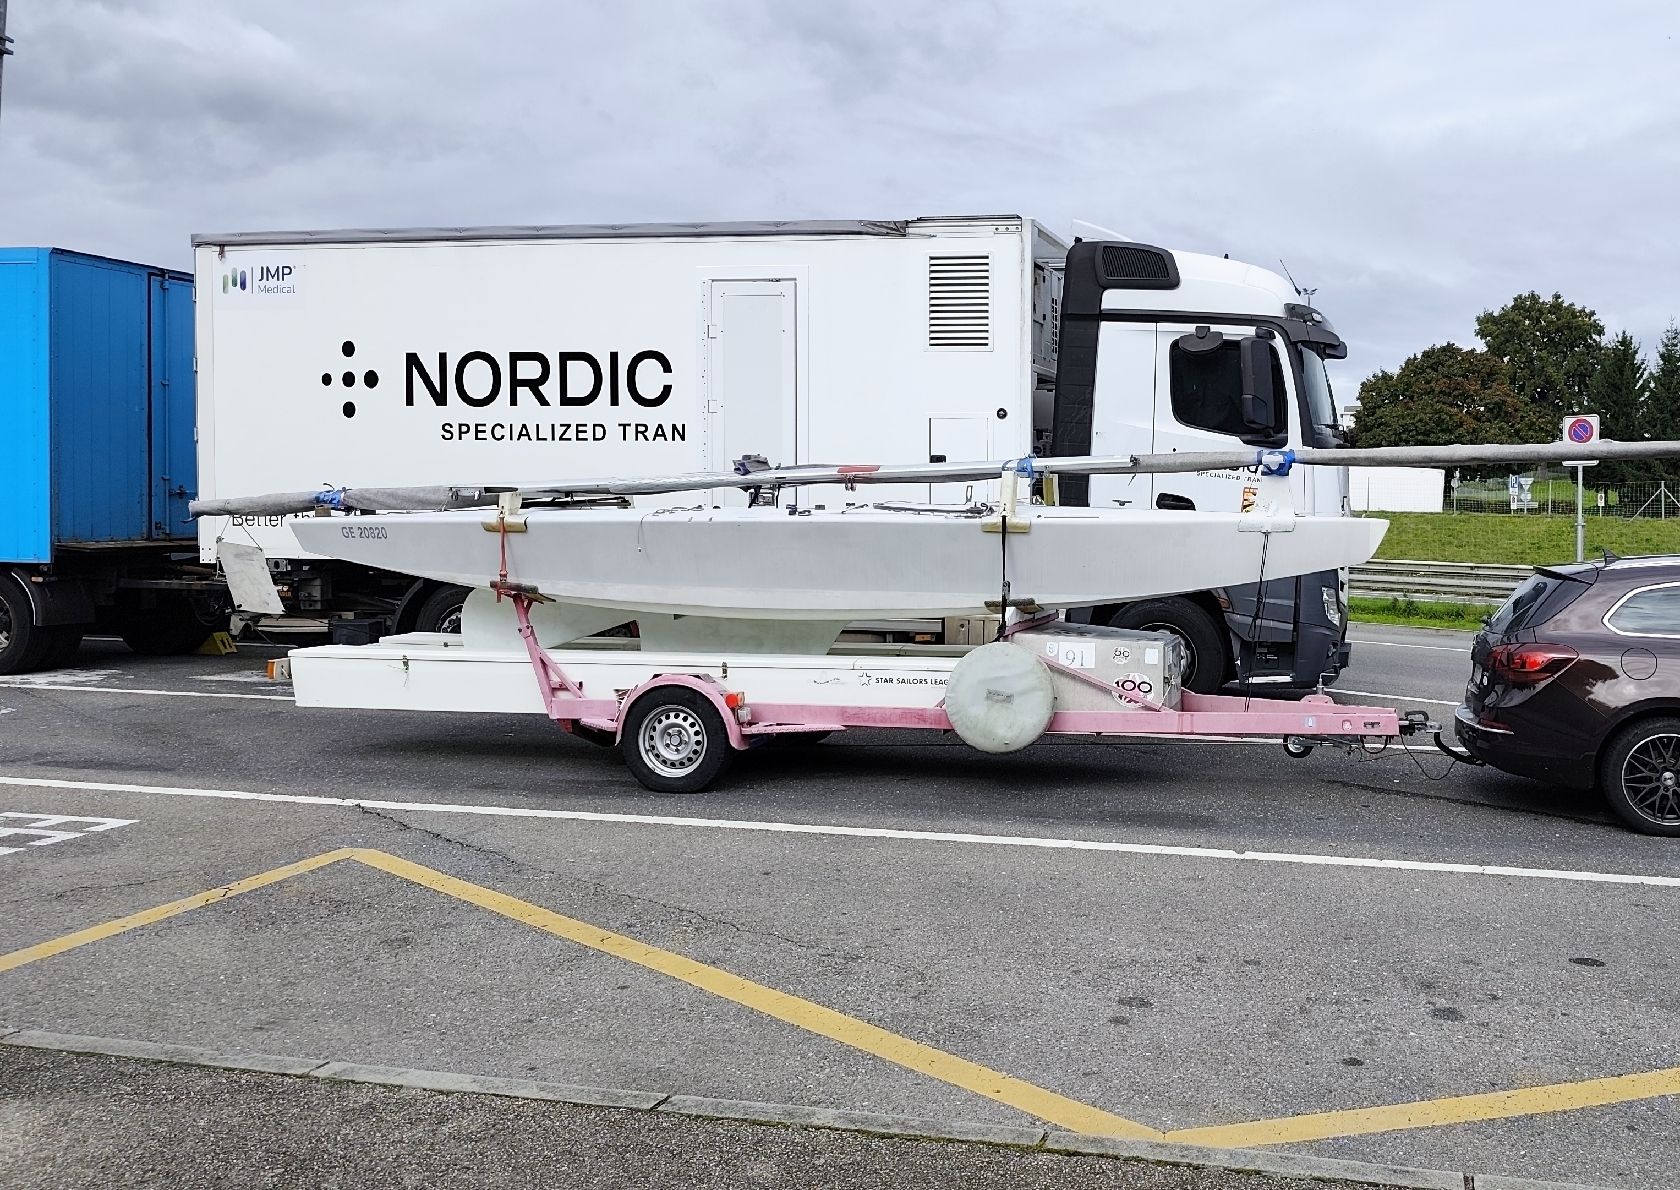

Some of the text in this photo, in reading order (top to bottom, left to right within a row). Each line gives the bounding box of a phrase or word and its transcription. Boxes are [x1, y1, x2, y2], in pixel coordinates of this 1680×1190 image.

[258, 284, 296, 294] Medical
[405, 349, 673, 408] NORDIC
[441, 421, 687, 442] SPECIALIZED TRAN
[341, 526, 388, 540] GE 20820
[1114, 679, 1153, 694] 100
